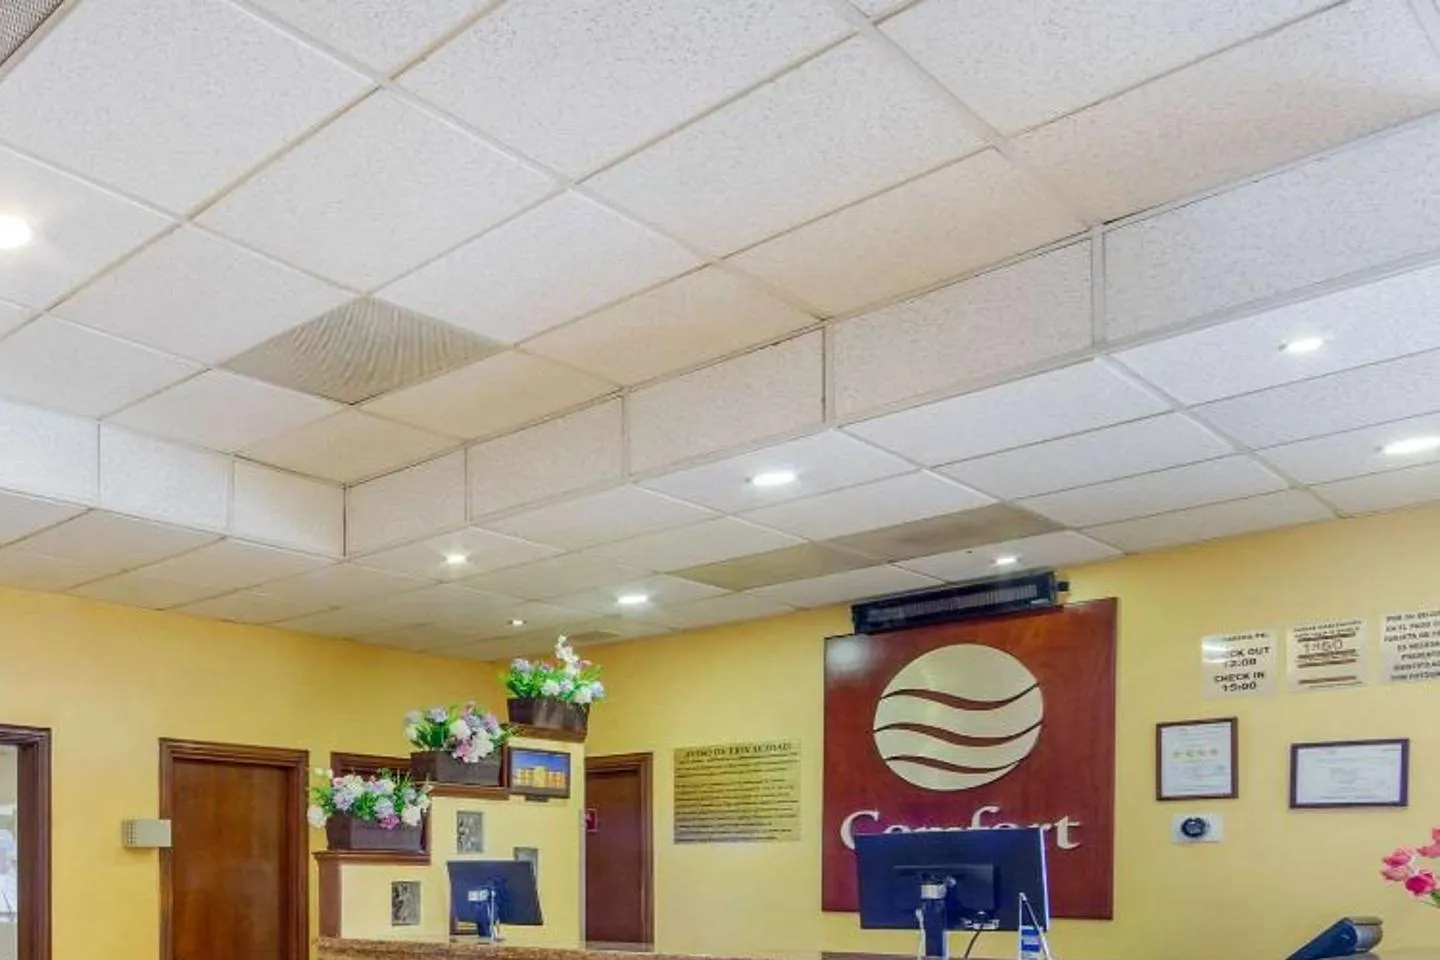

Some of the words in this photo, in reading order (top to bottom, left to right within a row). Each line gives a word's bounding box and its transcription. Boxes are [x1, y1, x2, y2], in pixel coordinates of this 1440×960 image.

[1247, 646, 1271, 656] OUT
[1213, 673, 1250, 683] CHECK
[1253, 671, 1265, 679] IN
